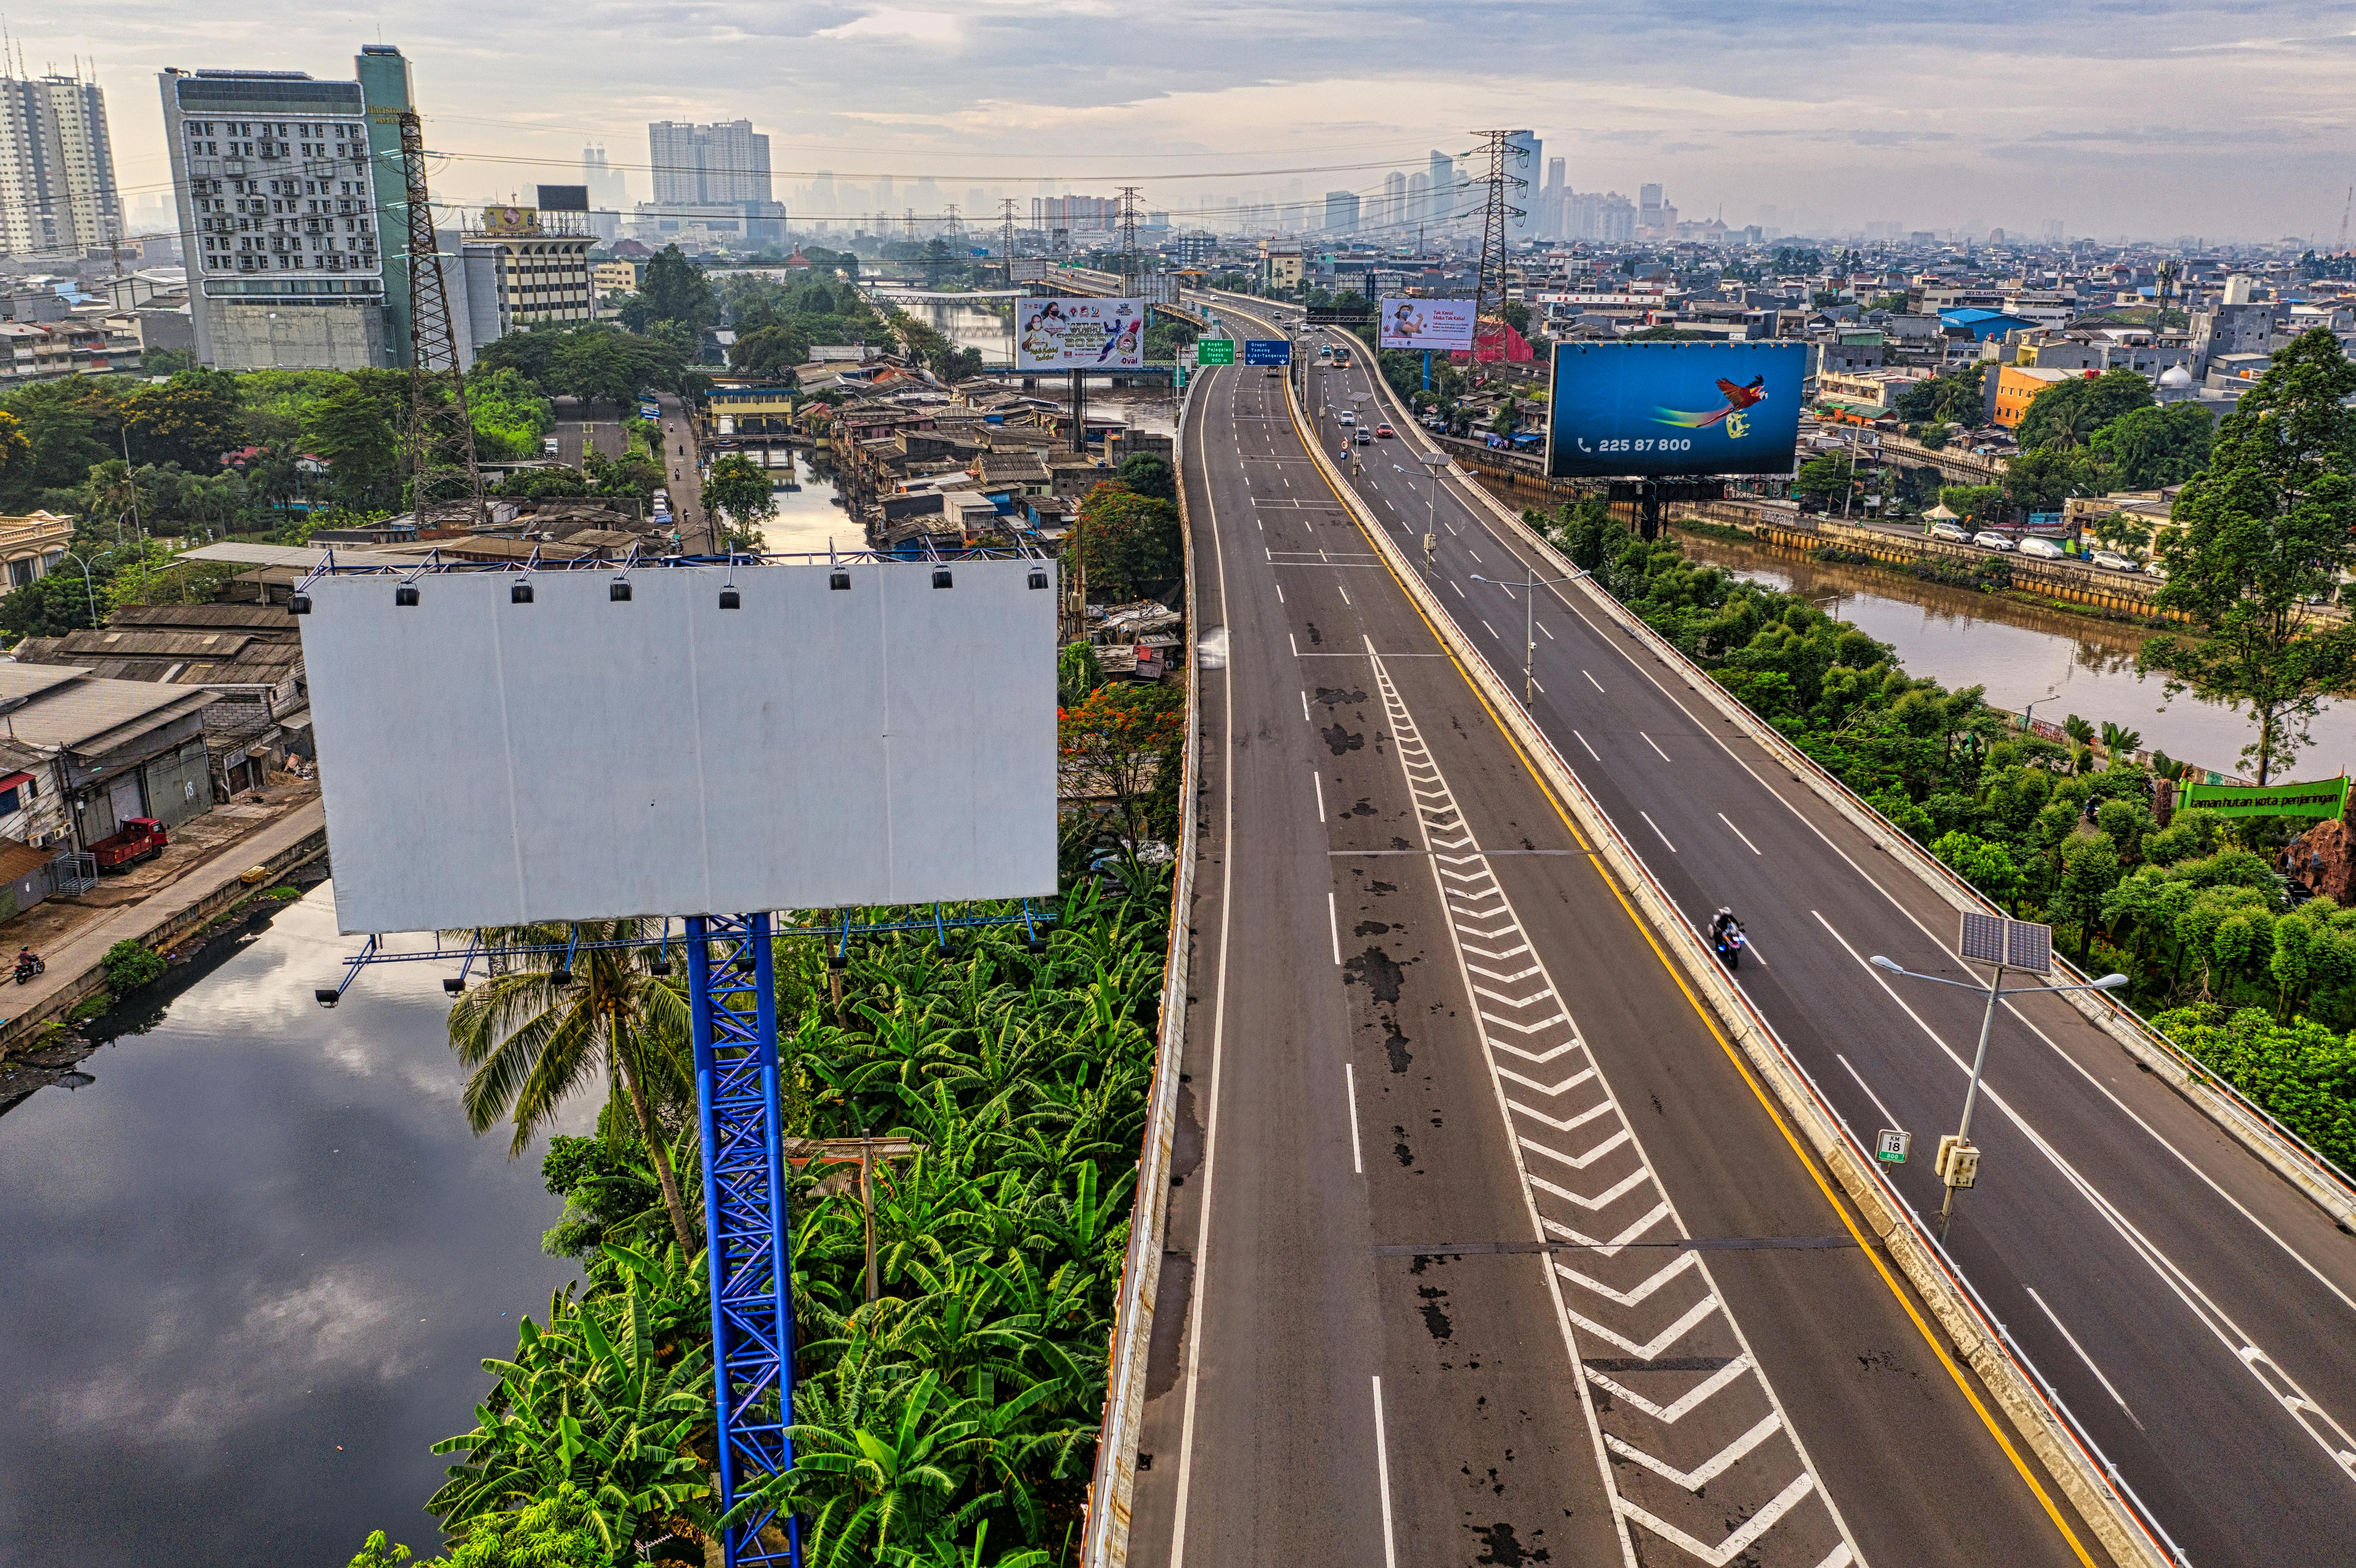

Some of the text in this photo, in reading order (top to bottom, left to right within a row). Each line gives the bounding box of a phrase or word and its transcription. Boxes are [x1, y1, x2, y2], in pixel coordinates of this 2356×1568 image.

[1064, 338, 1106, 347] 2020
[1599, 439, 1691, 451] 225 87 800
[185, 781, 194, 800] 18
[2190, 793, 2338, 808] taman hutan kota penjaringan
[1888, 1141, 1900, 1152] 18
